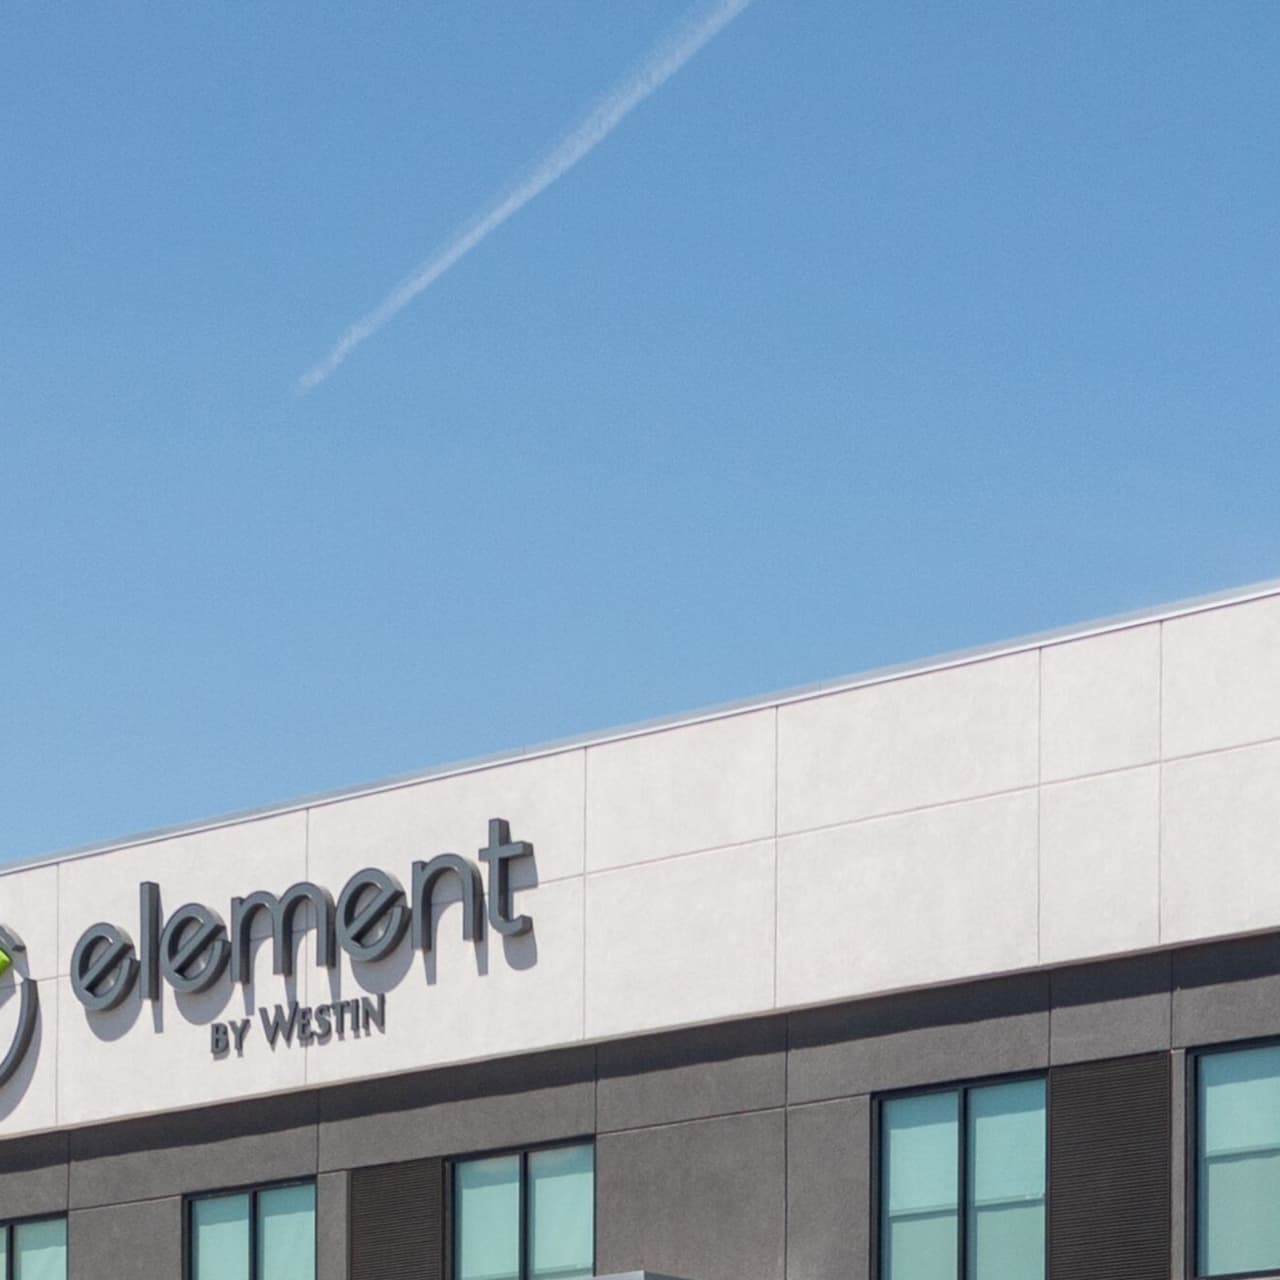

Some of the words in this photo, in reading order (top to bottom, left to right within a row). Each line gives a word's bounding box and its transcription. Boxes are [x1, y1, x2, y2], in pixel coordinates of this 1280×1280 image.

[71, 818, 534, 1010] element
[210, 1018, 251, 1055] BY
[258, 994, 386, 1050] WESTIN
